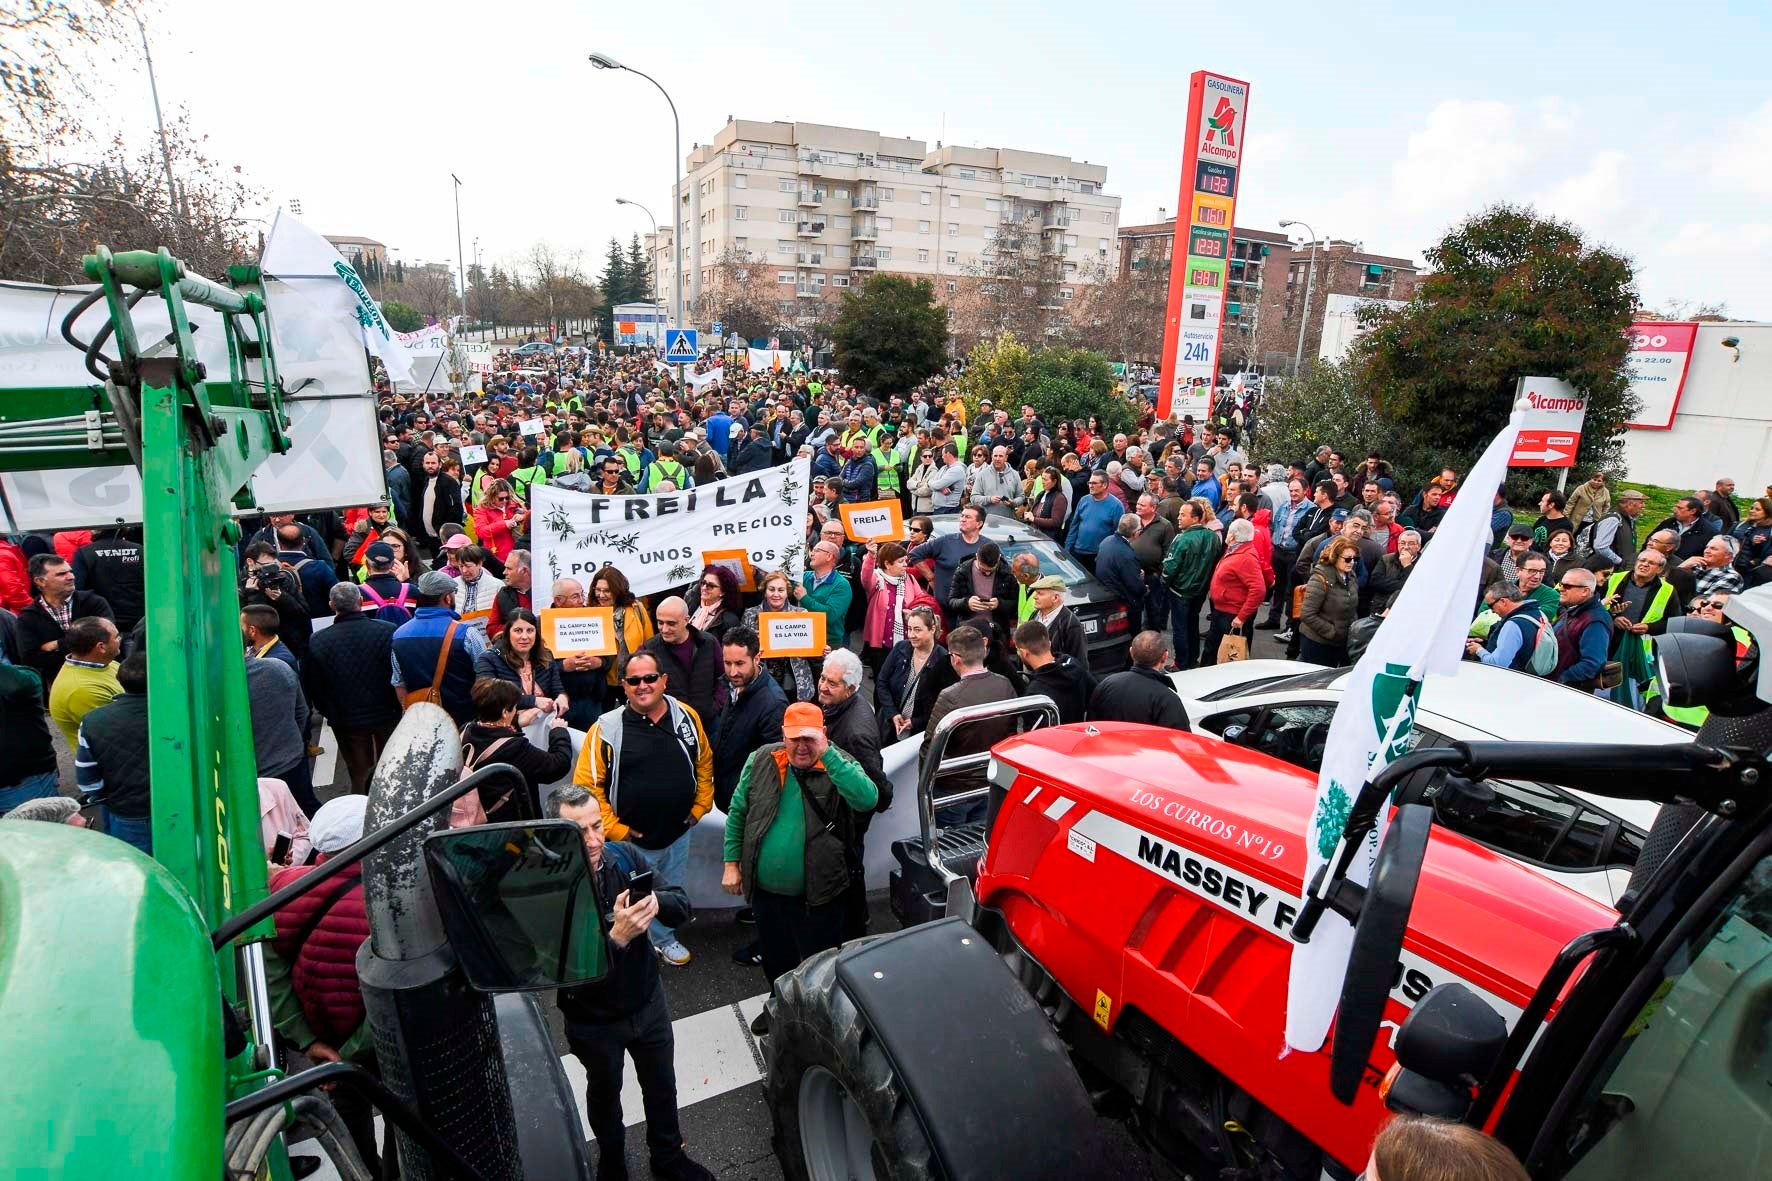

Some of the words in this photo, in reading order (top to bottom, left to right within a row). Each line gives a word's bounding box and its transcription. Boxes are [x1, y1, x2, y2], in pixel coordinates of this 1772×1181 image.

[1207, 79, 1244, 96] GASOLINERA
[1201, 142, 1237, 160] Alcampo
[1184, 331, 1214, 341] Autoservicio
[1184, 342, 1209, 361] 24h
[1528, 391, 1584, 413] Alcampo
[712, 515, 793, 537] PRECIOS
[853, 514, 887, 525] FREILA
[122, 555, 140, 563] Profi
[640, 546, 693, 565] UNOS
[1130, 788, 1164, 810] LOS
[1163, 801, 1237, 840] CURROS
[1137, 834, 1270, 917] MASSEY
